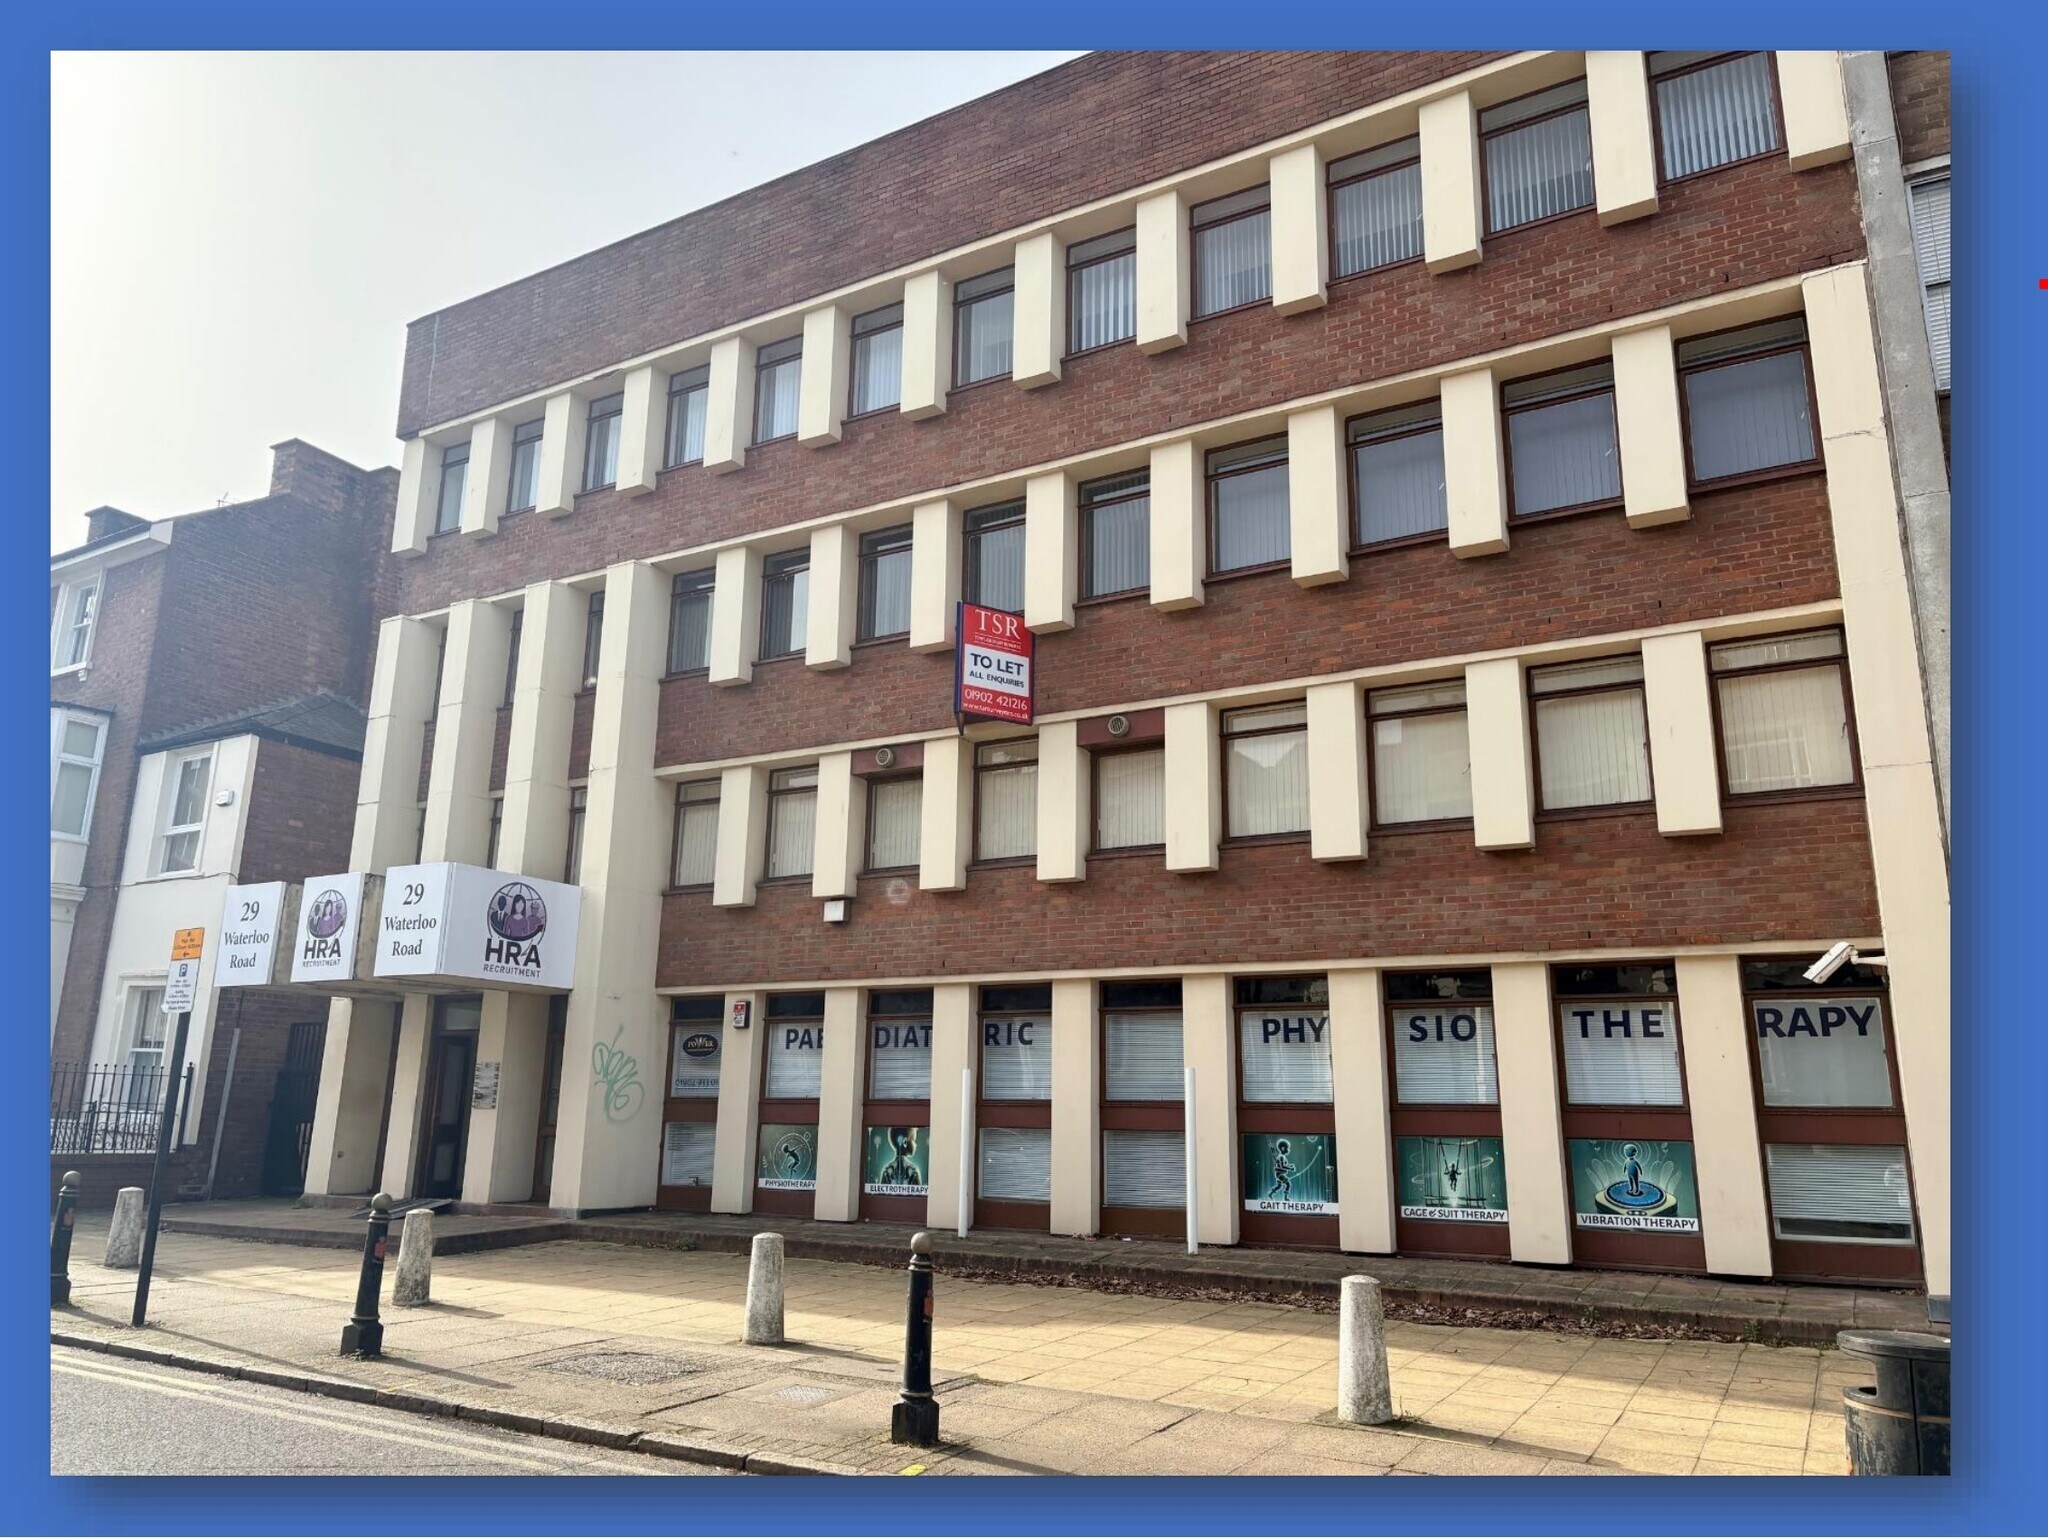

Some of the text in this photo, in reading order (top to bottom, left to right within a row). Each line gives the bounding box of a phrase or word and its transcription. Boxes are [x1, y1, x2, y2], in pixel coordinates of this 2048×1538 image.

[975, 609, 1020, 639] TSR
[971, 653, 1024, 676] TO LET
[969, 671, 1024, 688] ALL ENQUIRIES
[964, 688, 1028, 710] 01902 421216
[403, 883, 424, 906] 29
[240, 901, 260, 923] 29
[385, 914, 437, 932] Waterloo
[224, 931, 270, 946] Waterloo
[303, 938, 342, 960] HRA
[391, 939, 423, 957] Road
[485, 939, 541, 968] HRA
[229, 953, 257, 969] Road
[302, 958, 341, 968] RECRUITMENT
[483, 963, 542, 978] RECRUITMENT
[1262, 1005, 1875, 1043] PHY SIO THE RAPY
[874, 1026, 932, 1048] DIAT
[985, 1022, 1033, 1046] RIC
[765, 1180, 815, 1188] PHYSIOTHERAPY
[870, 1185, 928, 1194] ELECTROTHERAPY
[1259, 1201, 1324, 1212] GAIT THERAPY
[1403, 1208, 1428, 1217] CAGE
[1438, 1210, 1460, 1219] SUIT
[1461, 1211, 1506, 1222] THERAPY
[1581, 1215, 1696, 1230] VIBRATION THERAPY
